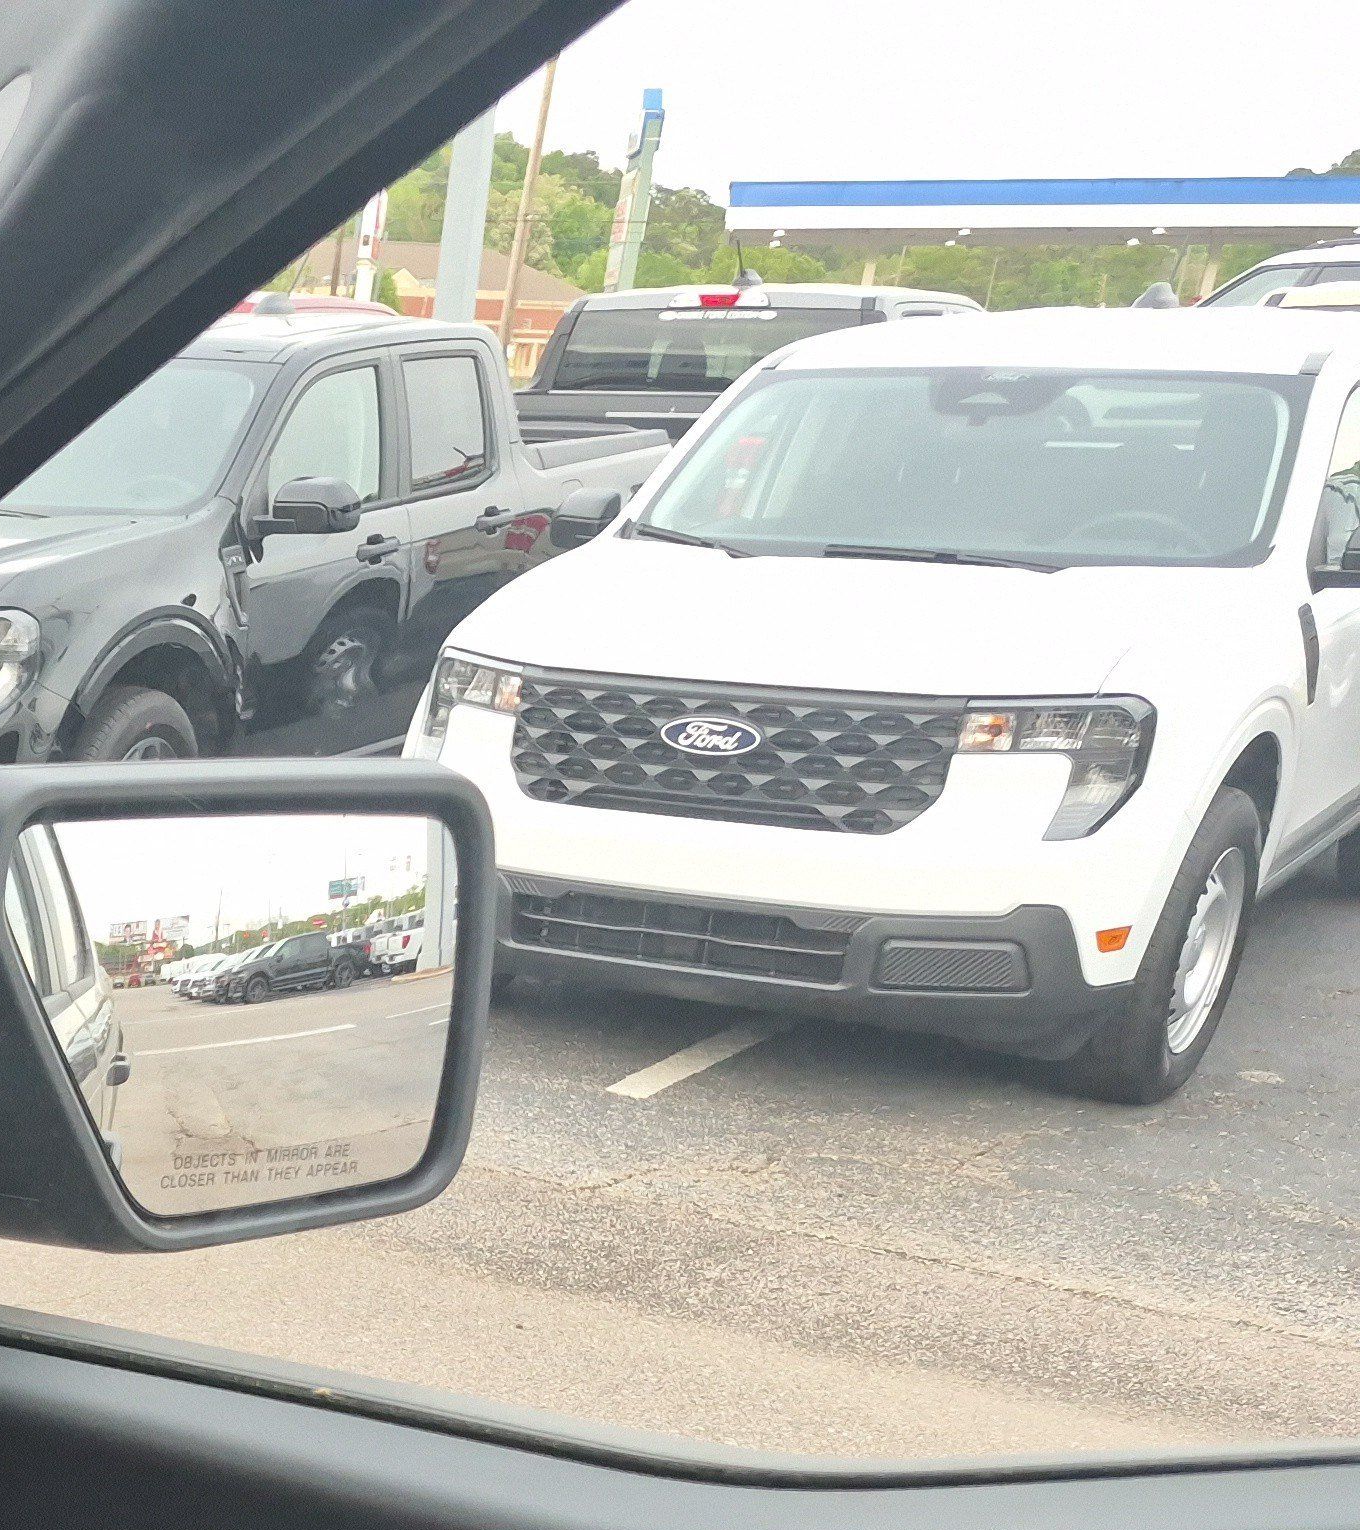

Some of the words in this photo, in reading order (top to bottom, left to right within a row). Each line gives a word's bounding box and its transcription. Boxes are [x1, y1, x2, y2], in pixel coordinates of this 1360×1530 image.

[678, 721, 742, 750] Ford
[173, 1151, 236, 1171] OBJECTS
[245, 1149, 259, 1166] IN
[266, 1146, 318, 1164] MIRROR
[324, 1143, 351, 1159] ARE
[160, 1173, 215, 1190] CLOSER
[223, 1170, 259, 1185] THAN
[267, 1166, 300, 1182] THEY
[306, 1161, 358, 1177] APPEAR
